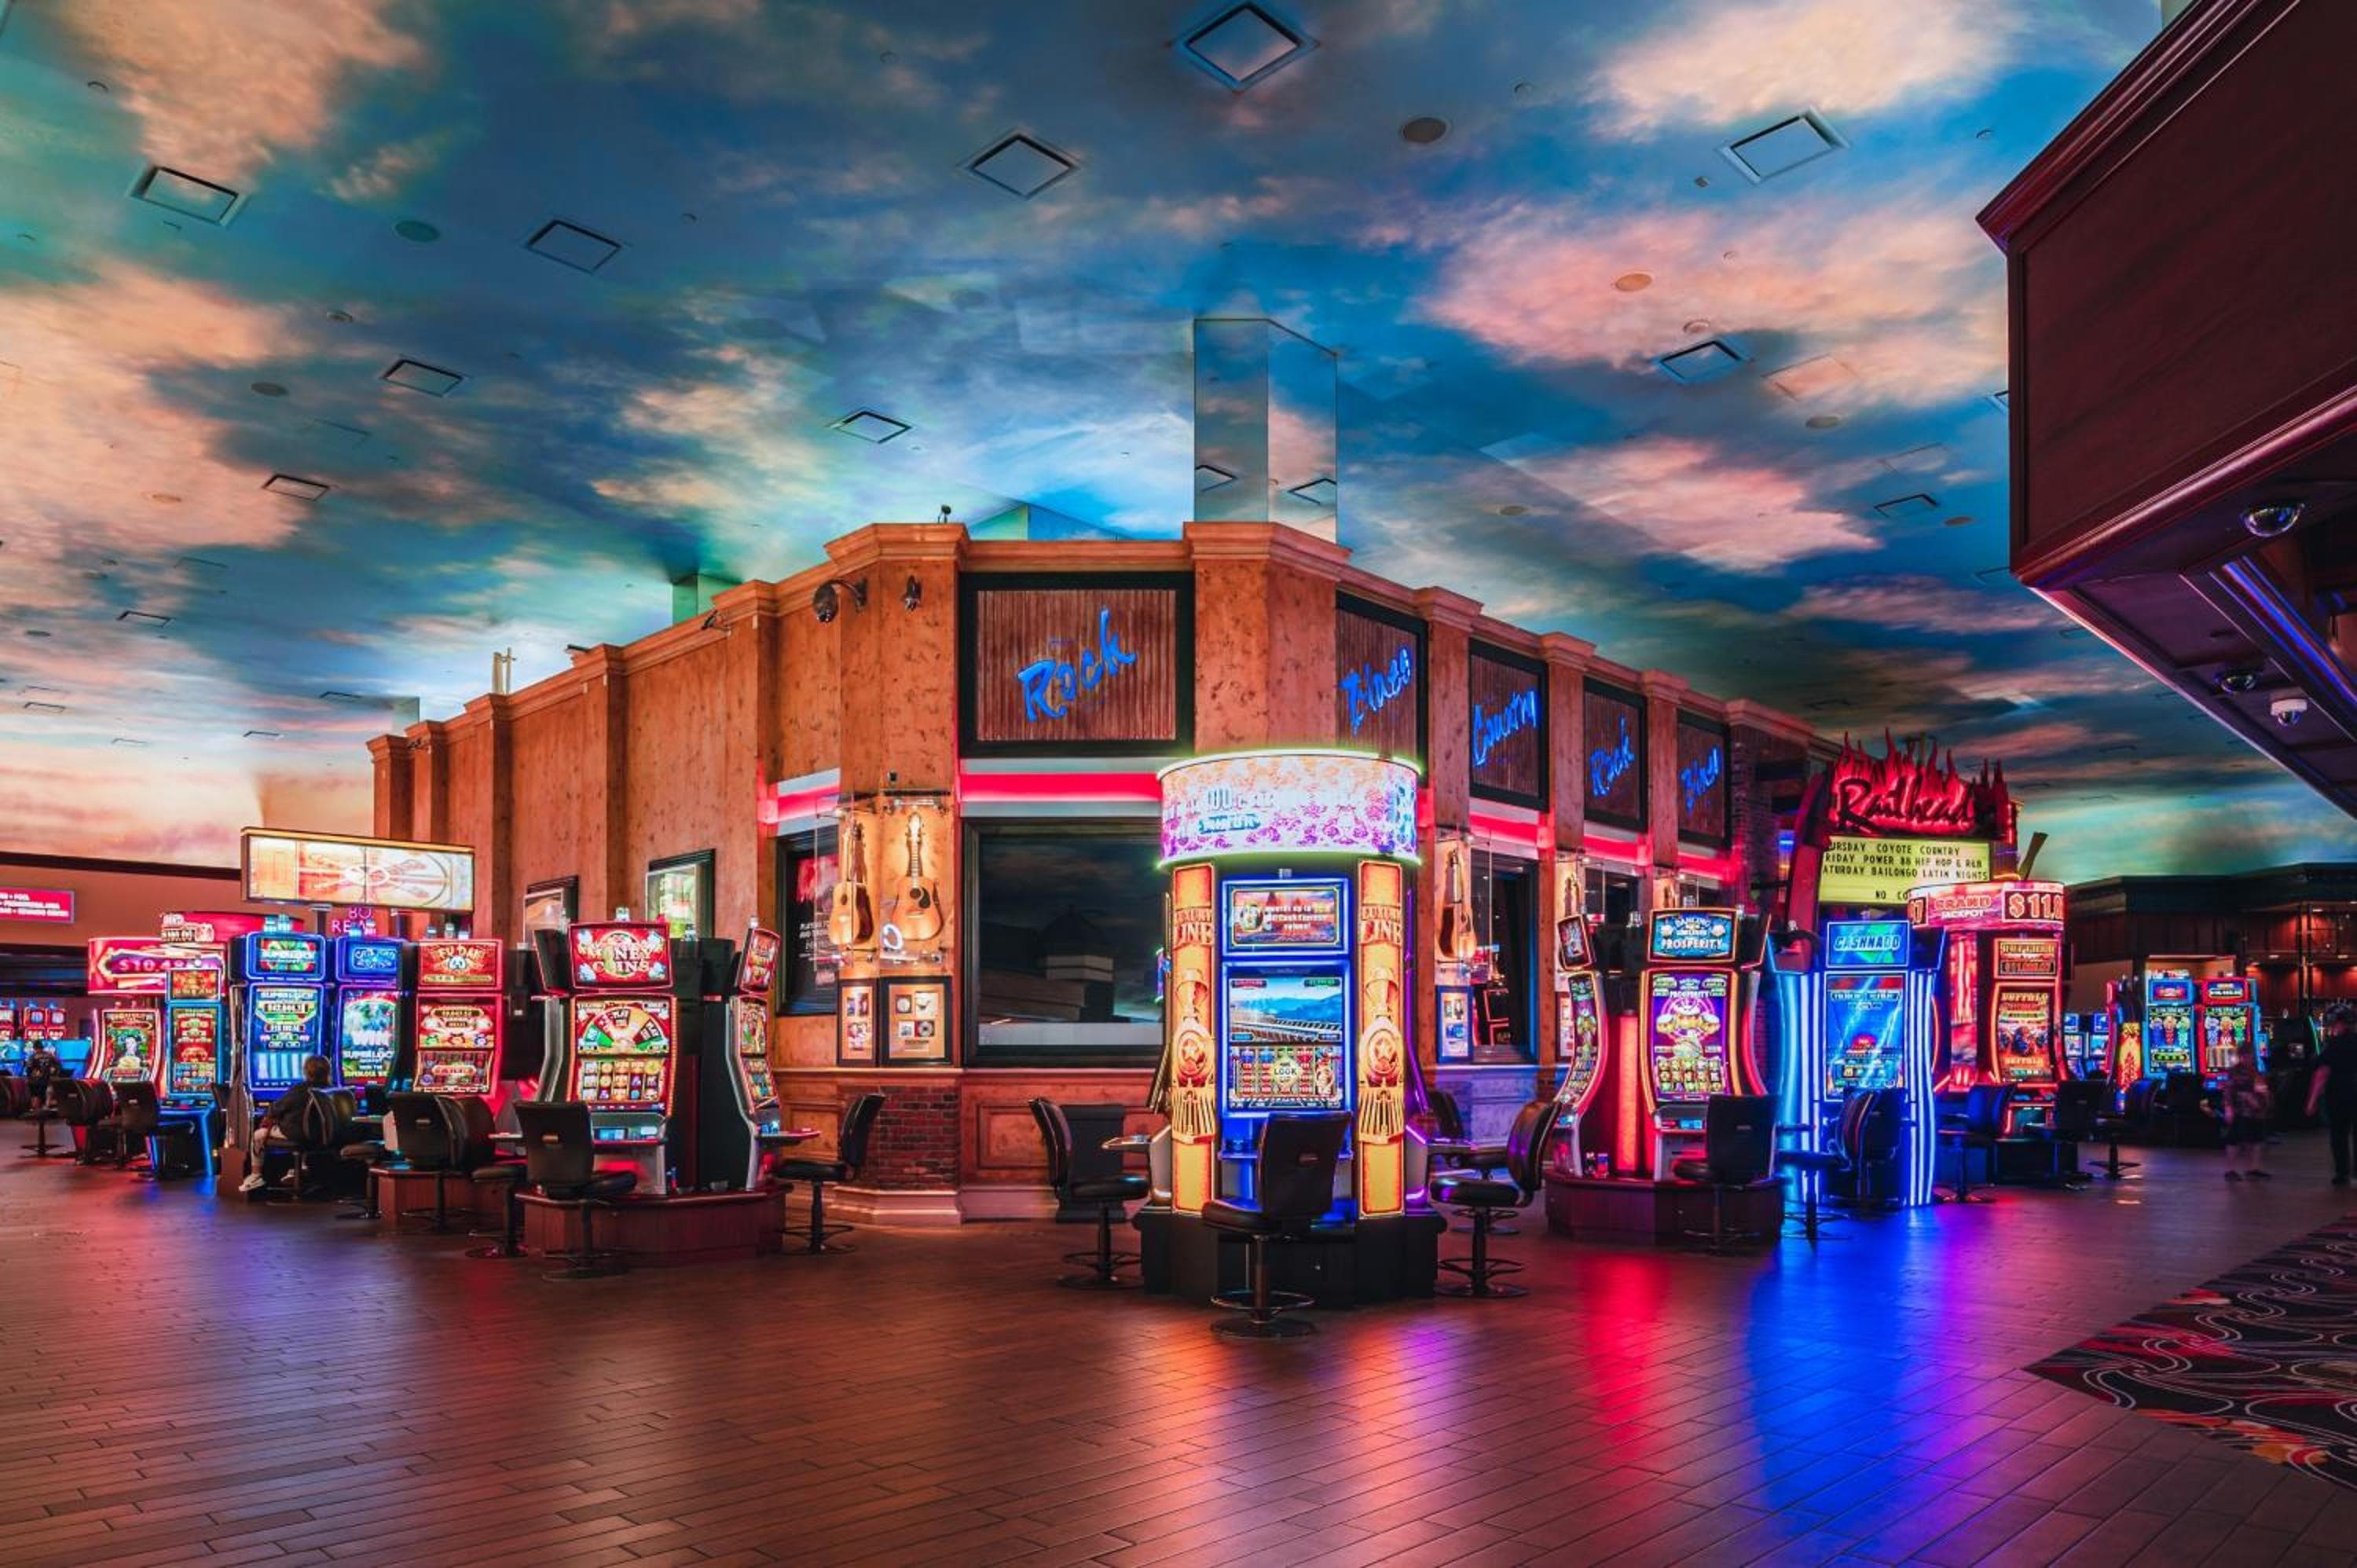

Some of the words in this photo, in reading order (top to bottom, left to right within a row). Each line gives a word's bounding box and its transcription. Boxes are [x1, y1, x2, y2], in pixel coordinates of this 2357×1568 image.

[1016, 606, 1138, 723] Rock
[1589, 716, 1635, 798] Rock
[1837, 776, 1975, 834] Railhead
[1876, 843, 1912, 854] COYOTE
[1919, 844, 1960, 855] COUNTRY
[1825, 852, 1855, 863] RIDAY
[1863, 853, 1893, 865] POWER
[1822, 865, 1865, 875] ATURDAY
[1923, 869, 1949, 878] LATIN
[1956, 870, 1988, 881] NIGHTS
[1875, 889, 1886, 899] NO
[1934, 894, 1992, 910] GRAND
[1941, 910, 1985, 919] JACKPOT
[1661, 937, 1724, 950] PROSPERITY
[1833, 933, 1901, 951] CASHNADO
